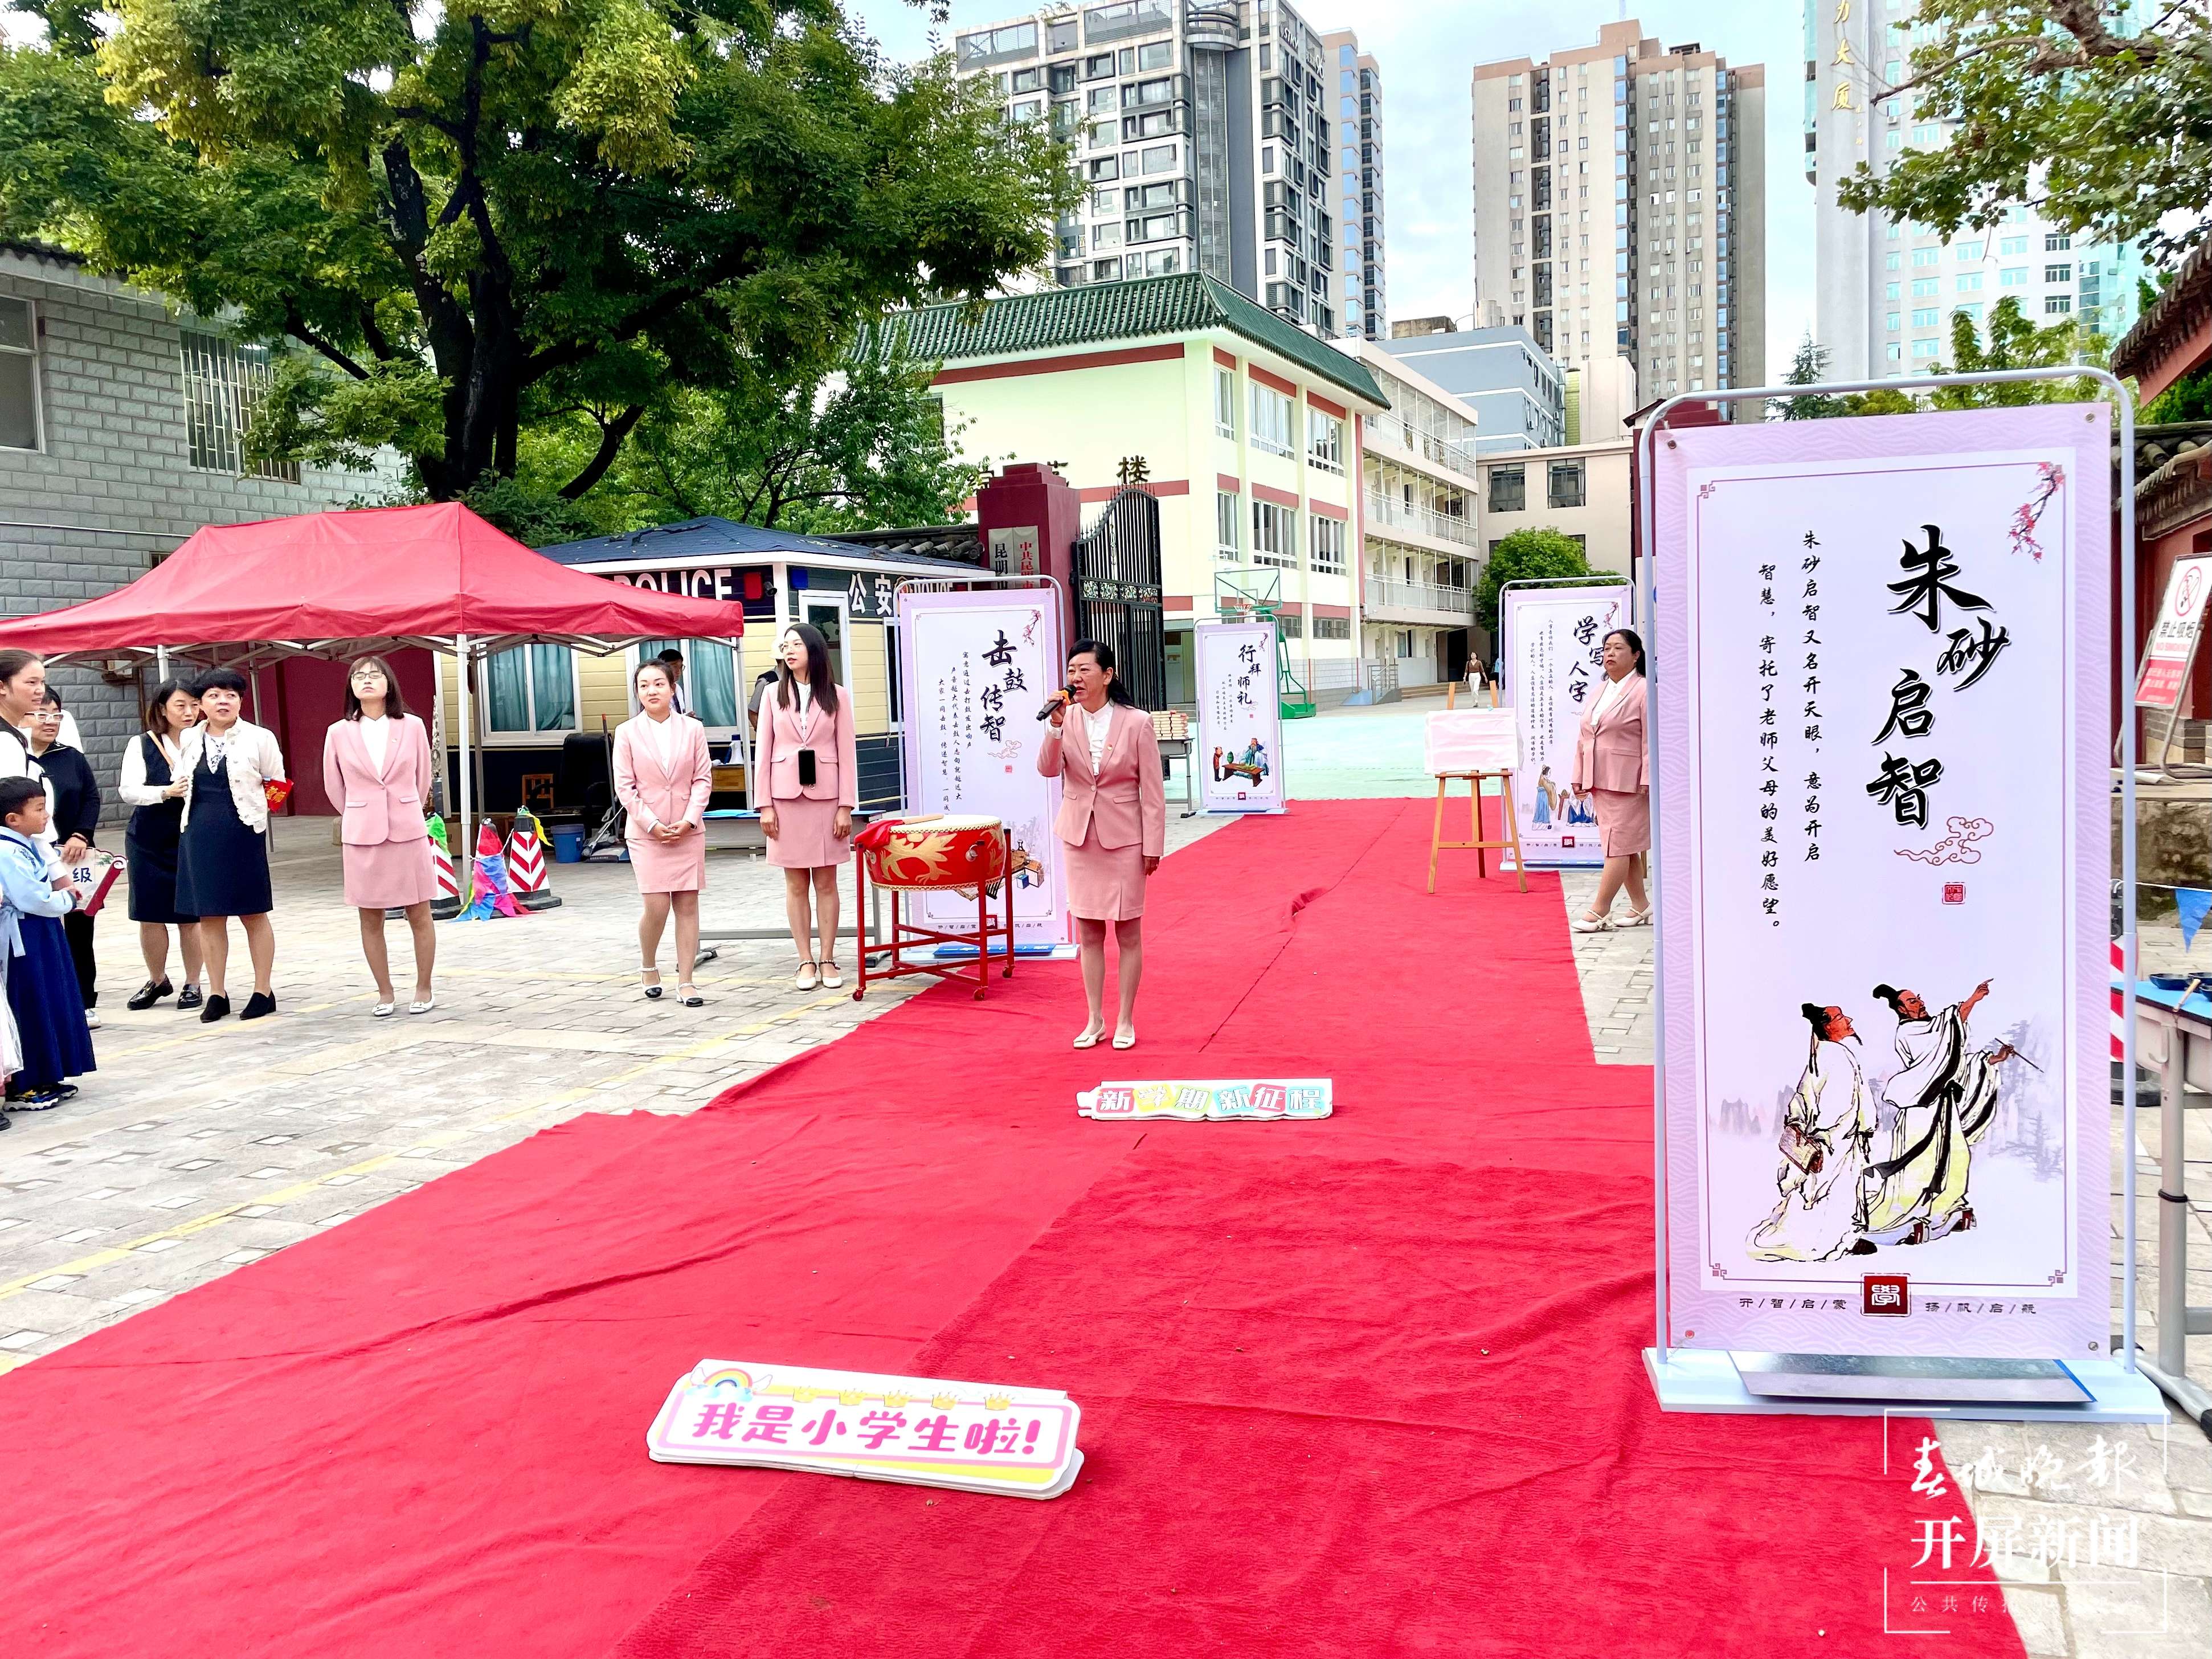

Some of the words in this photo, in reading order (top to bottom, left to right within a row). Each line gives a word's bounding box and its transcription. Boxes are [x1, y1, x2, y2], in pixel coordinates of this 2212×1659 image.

[848, 573, 892, 615] 公安
[979, 629, 1028, 743] 击鼓传智
[1236, 644, 1262, 705] 行拜师礼
[1801, 530, 1823, 862] 朱砂启智又名开天眼，意为开启
[1866, 524, 2011, 830] 朱砂启智
[1758, 563, 1780, 930] 智慧，寄托了老师父母的美好愿望。
[72, 868, 92, 883] 级
[1099, 1085, 1323, 1112] 新学期新征程
